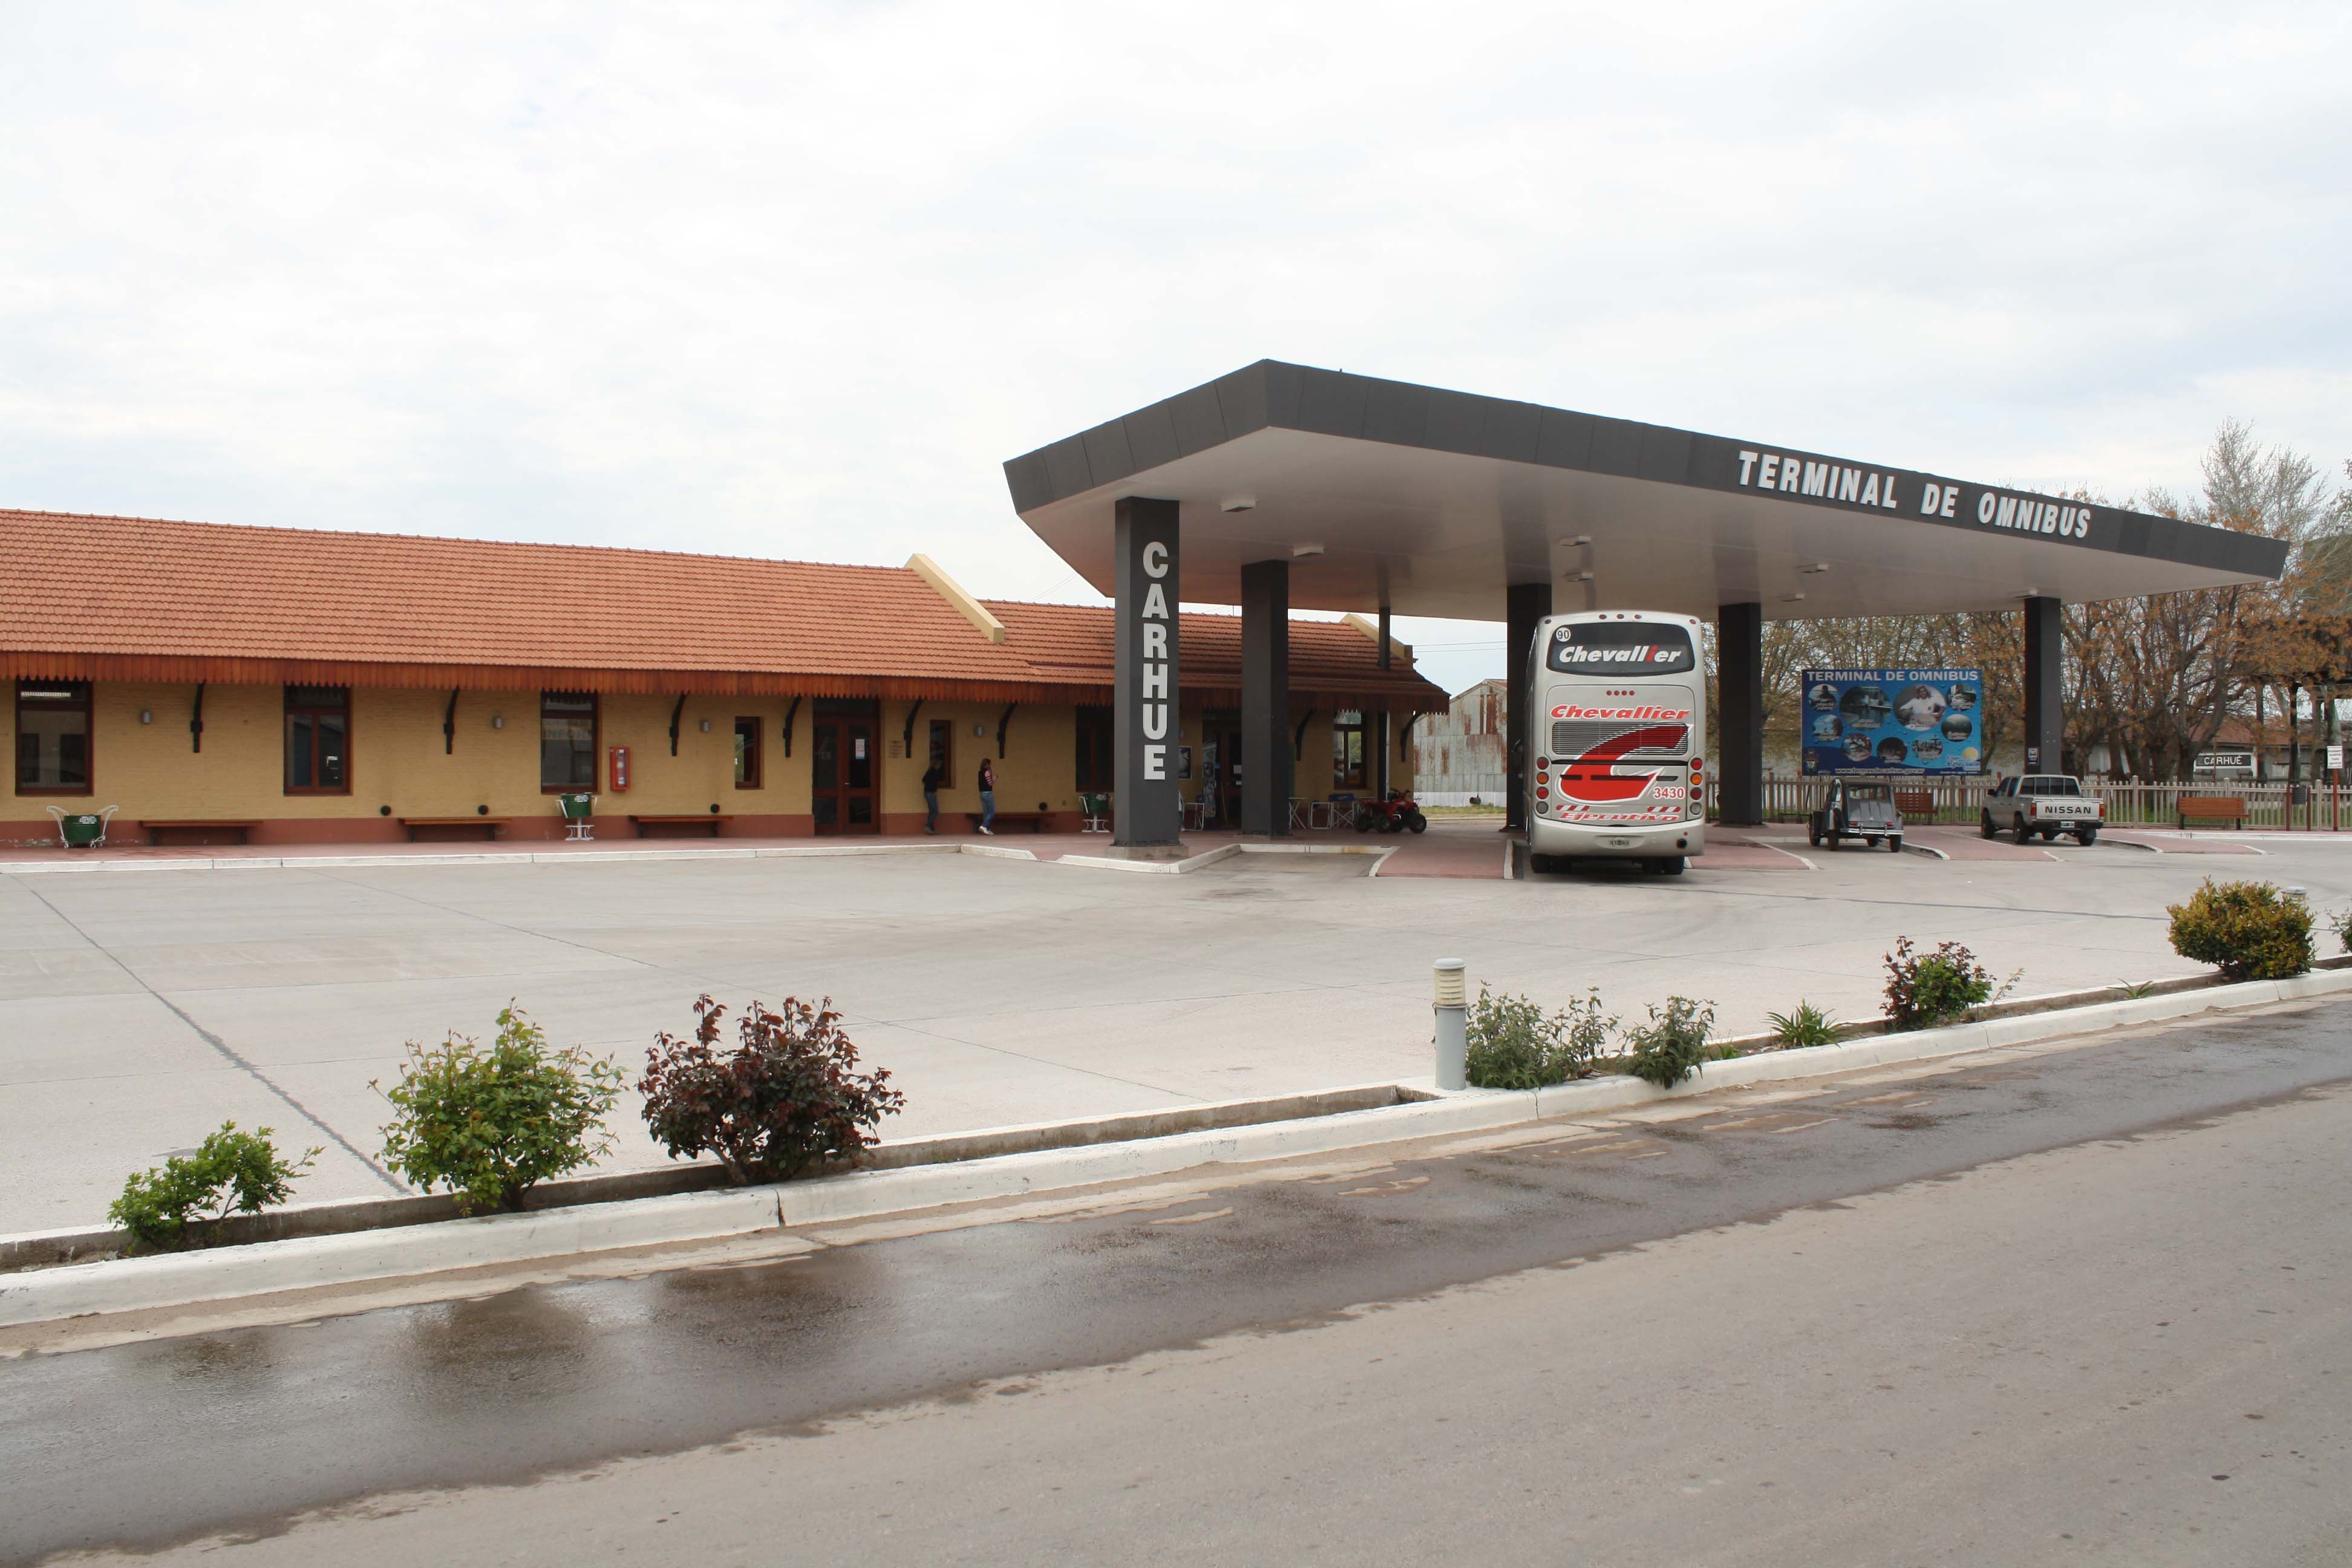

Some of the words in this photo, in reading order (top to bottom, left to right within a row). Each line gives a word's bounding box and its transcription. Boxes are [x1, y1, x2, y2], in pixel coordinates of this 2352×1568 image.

[1738, 450, 1897, 509] TERMINAL
[1920, 483, 1960, 518] DE
[1977, 491, 2091, 538] OMNIBUS
[1557, 630, 1570, 639] 90
[1559, 644, 1682, 663] Chevallier
[1142, 541, 1169, 780] CARHUE
[1806, 671, 1881, 682] TERMINAL
[1886, 671, 1905, 681] DE
[1909, 670, 1979, 681] OMNIBUS
[1550, 704, 1691, 720] Chevallier
[2204, 755, 2243, 765] CARHUÉ
[1653, 787, 1685, 799] 3430
[2045, 805, 2091, 814] NISSAN
[1557, 812, 1680, 823] Ejecutivo
